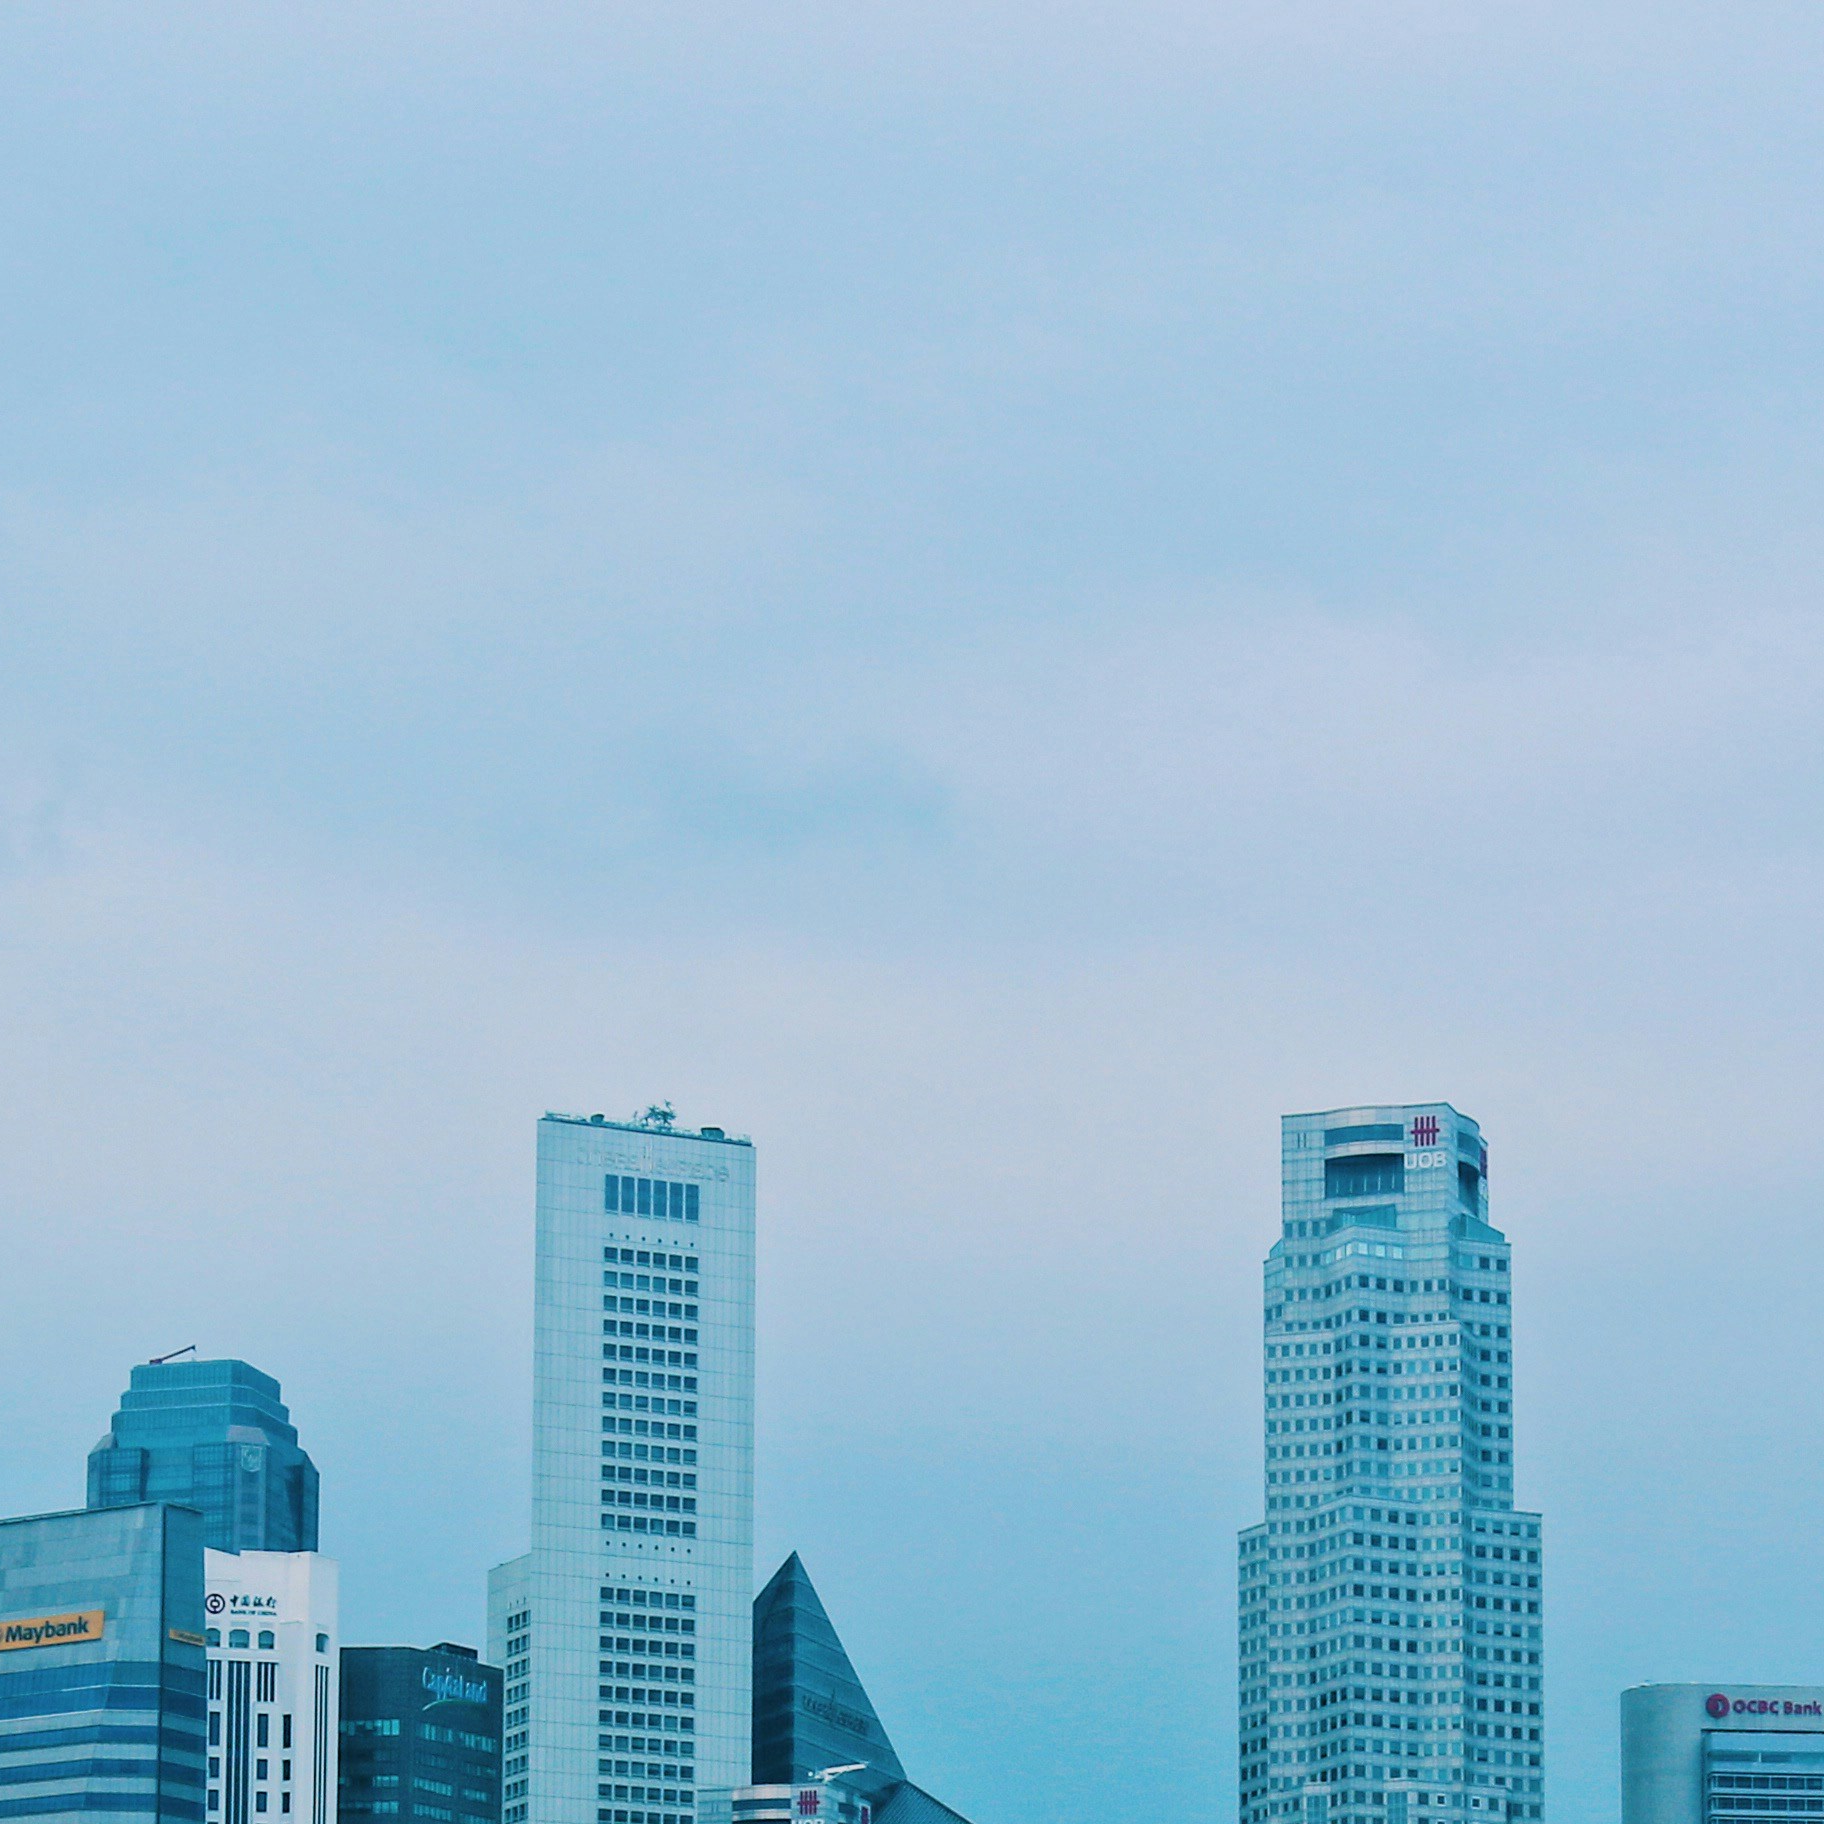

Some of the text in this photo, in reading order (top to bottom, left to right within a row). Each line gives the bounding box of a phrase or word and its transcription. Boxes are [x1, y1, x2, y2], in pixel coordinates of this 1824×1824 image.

[1404, 1151, 1446, 1169] UOB
[5, 1616, 89, 1644] Maybank
[1733, 1699, 1822, 1716] OCBC Bank
